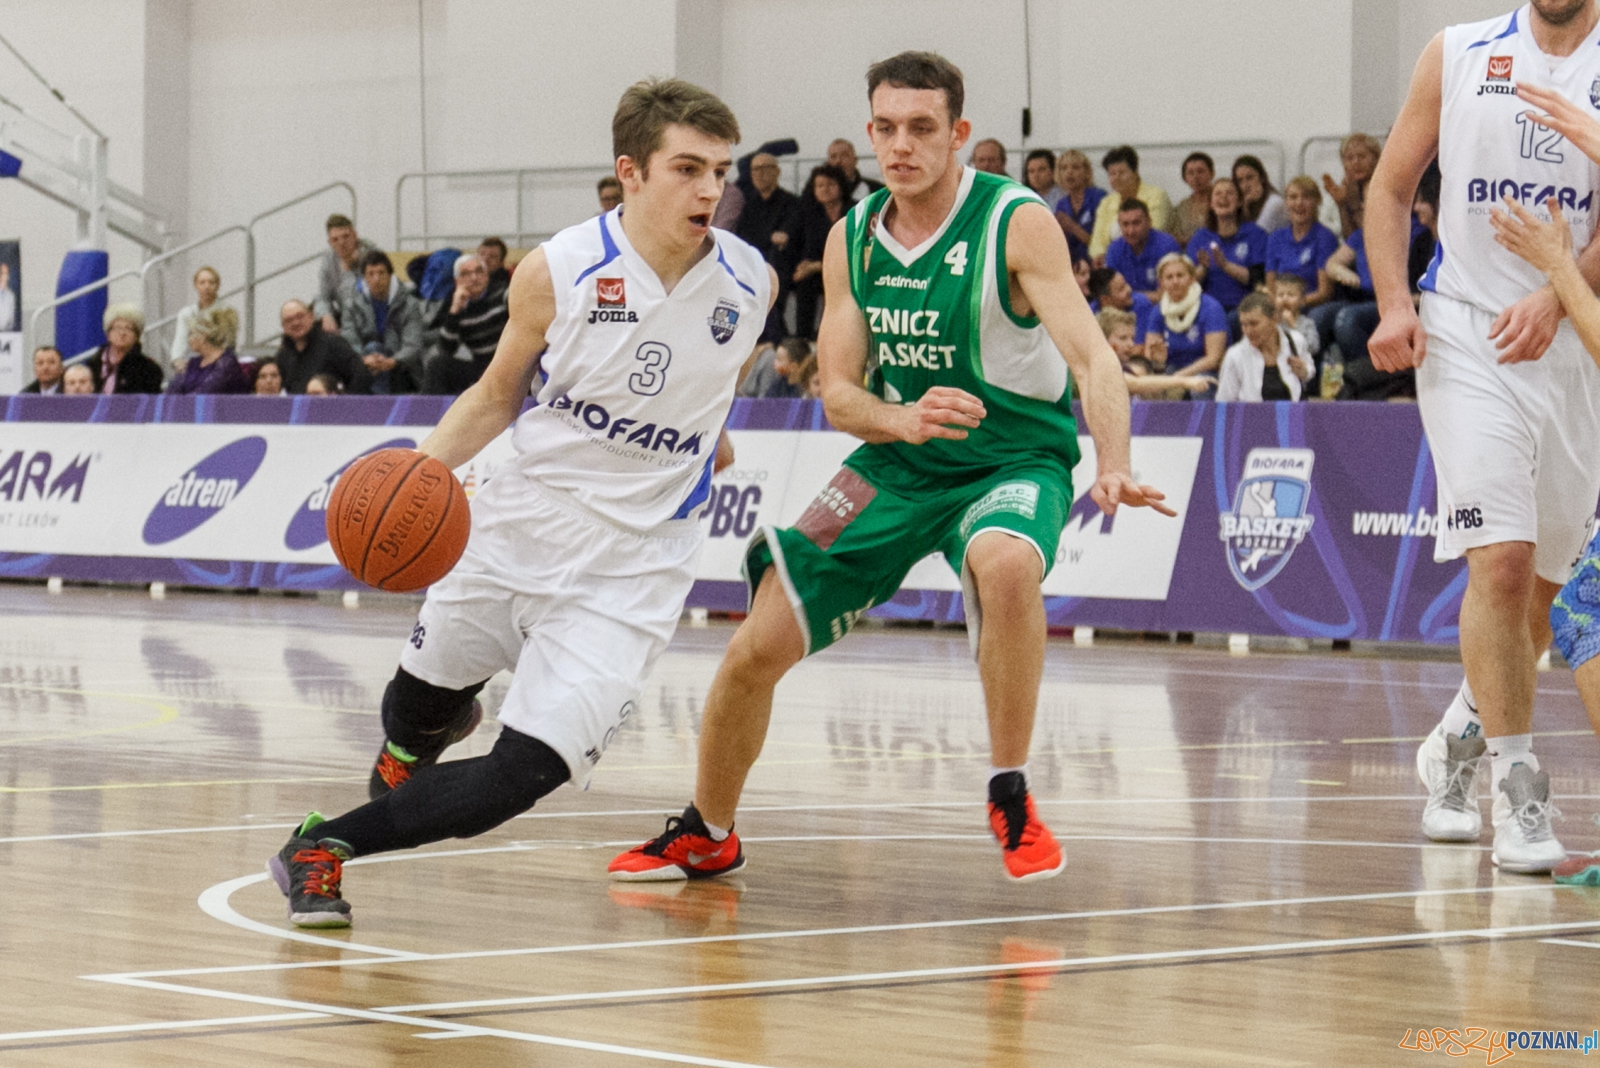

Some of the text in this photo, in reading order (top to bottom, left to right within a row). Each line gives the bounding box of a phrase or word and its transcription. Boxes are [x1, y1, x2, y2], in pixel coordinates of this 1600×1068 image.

[1515, 109, 1564, 164] 12
[944, 241, 968, 276] 4
[866, 306, 940, 337] ZNICZ
[629, 341, 671, 396] 3
[879, 342, 956, 370] ASKET
[0, 450, 93, 503] ARM
[165, 471, 238, 508] atrem
[376, 468, 442, 560] SPALDING
[1222, 514, 1313, 540] BASKET
[1455, 507, 1483, 530] PBG
